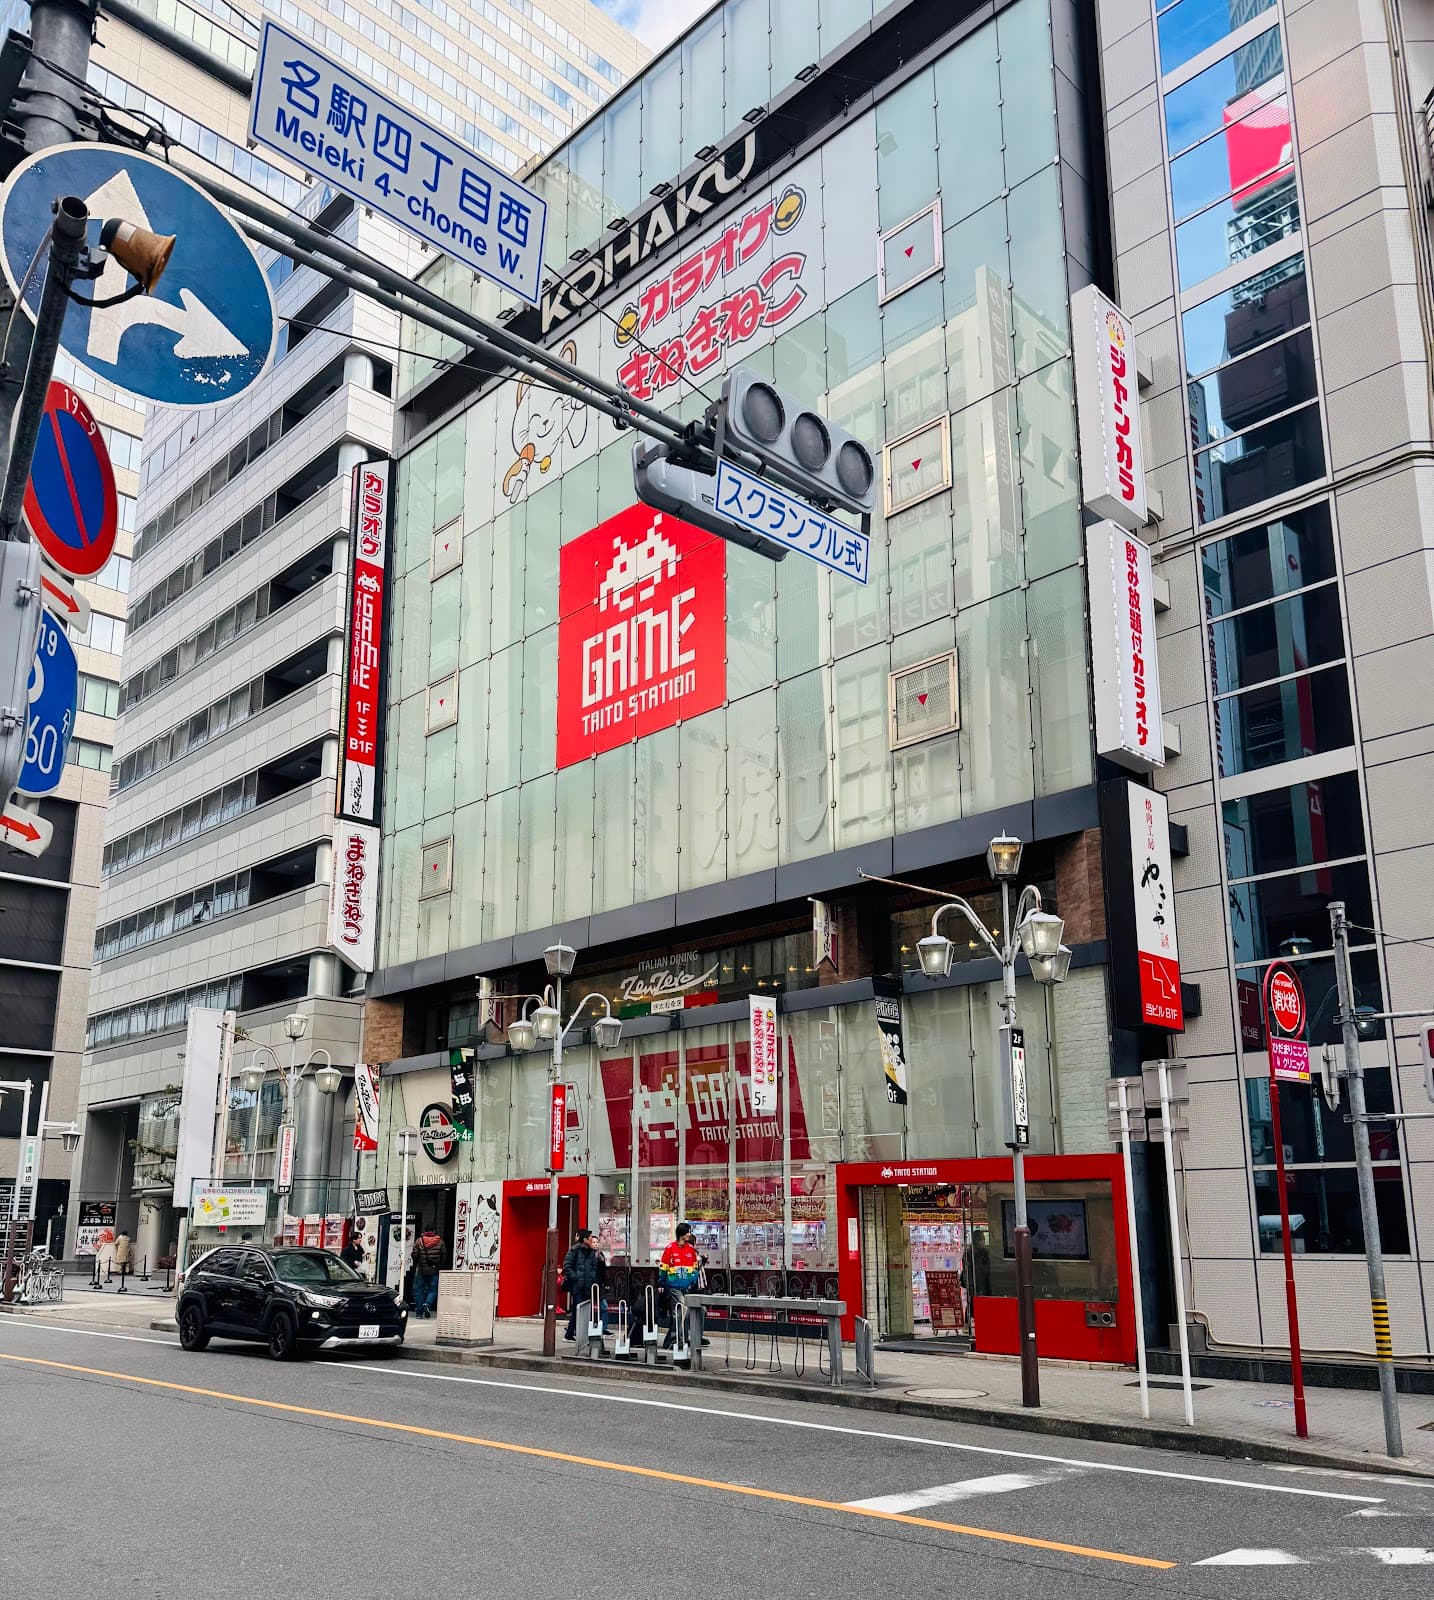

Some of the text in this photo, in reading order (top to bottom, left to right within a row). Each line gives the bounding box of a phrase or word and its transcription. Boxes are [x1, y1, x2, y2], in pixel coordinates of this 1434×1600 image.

[279, 60, 532, 248] 名駅四丁目西
[275, 108, 525, 280] Meieki 4-chome W.
[541, 132, 757, 335] KOHAKU
[637, 201, 777, 331] カラオケ
[617, 251, 808, 402] まねきねこ
[63, 389, 98, 437] 19-9
[1110, 344, 1136, 502] ジャンカラ
[363, 471, 384, 556] カラオケ
[724, 475, 863, 573] スクランブル式
[360, 592, 378, 690] GAME
[581, 586, 696, 709] GAME
[1125, 540, 1149, 747] 飲み放題付カラオケ
[356, 701, 370, 715] 1F
[581, 668, 696, 737] TAITO STATION
[349, 738, 374, 754] B1F
[342, 834, 367, 945] まねきねこ
[638, 950, 699, 972] ITALIAN DINING
[1145, 1002, 1165, 1018] 当ビル
[1273, 989, 1299, 1015] 消火栓
[765, 1022, 775, 1073] カラオケ
[1272, 1042, 1308, 1058] ひだまりこころ
[1282, 1057, 1305, 1071] クリニック
[690, 1070, 777, 1122] GAM
[754, 1091, 767, 1107] 5F
[354, 1137, 367, 1150] 2F
[894, 1167, 938, 1177] TAITO STATION
[456, 1201, 467, 1269] カラオケ
